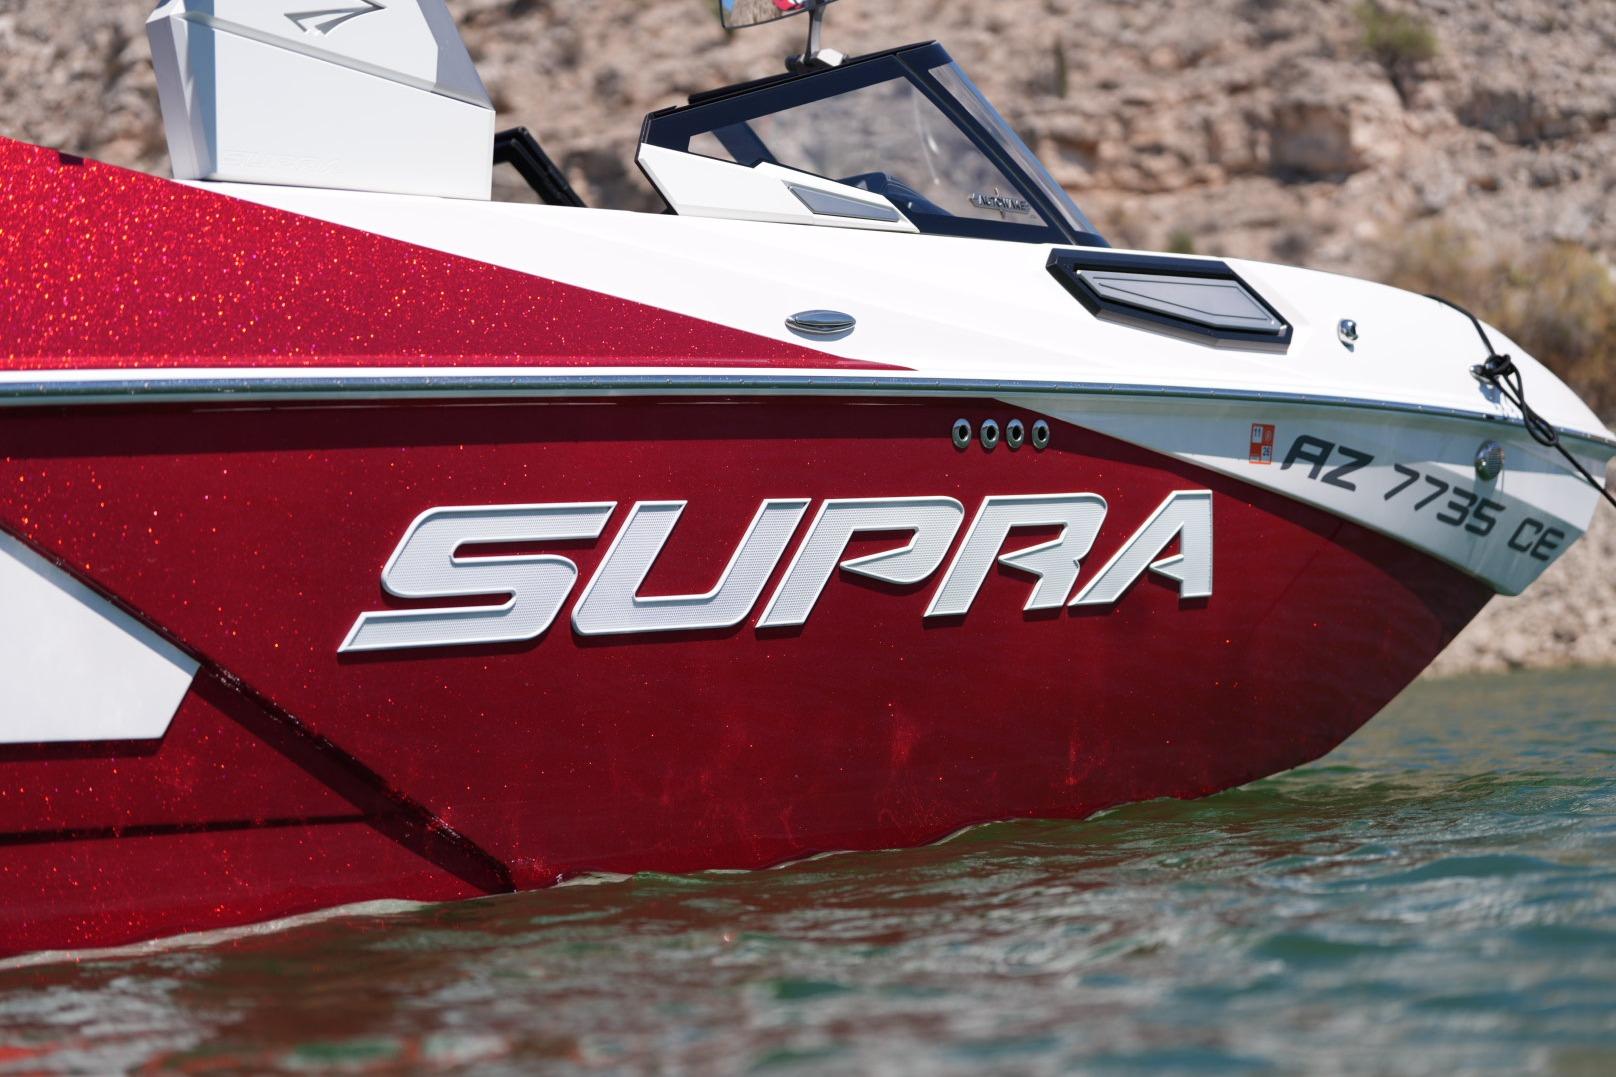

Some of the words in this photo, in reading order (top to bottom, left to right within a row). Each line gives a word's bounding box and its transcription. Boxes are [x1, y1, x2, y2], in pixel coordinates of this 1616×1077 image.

[337, 489, 1214, 653] SUPRA
[1280, 434, 1375, 492] AZ
[1384, 463, 1506, 537] 7735
[1507, 517, 1565, 562] CE
